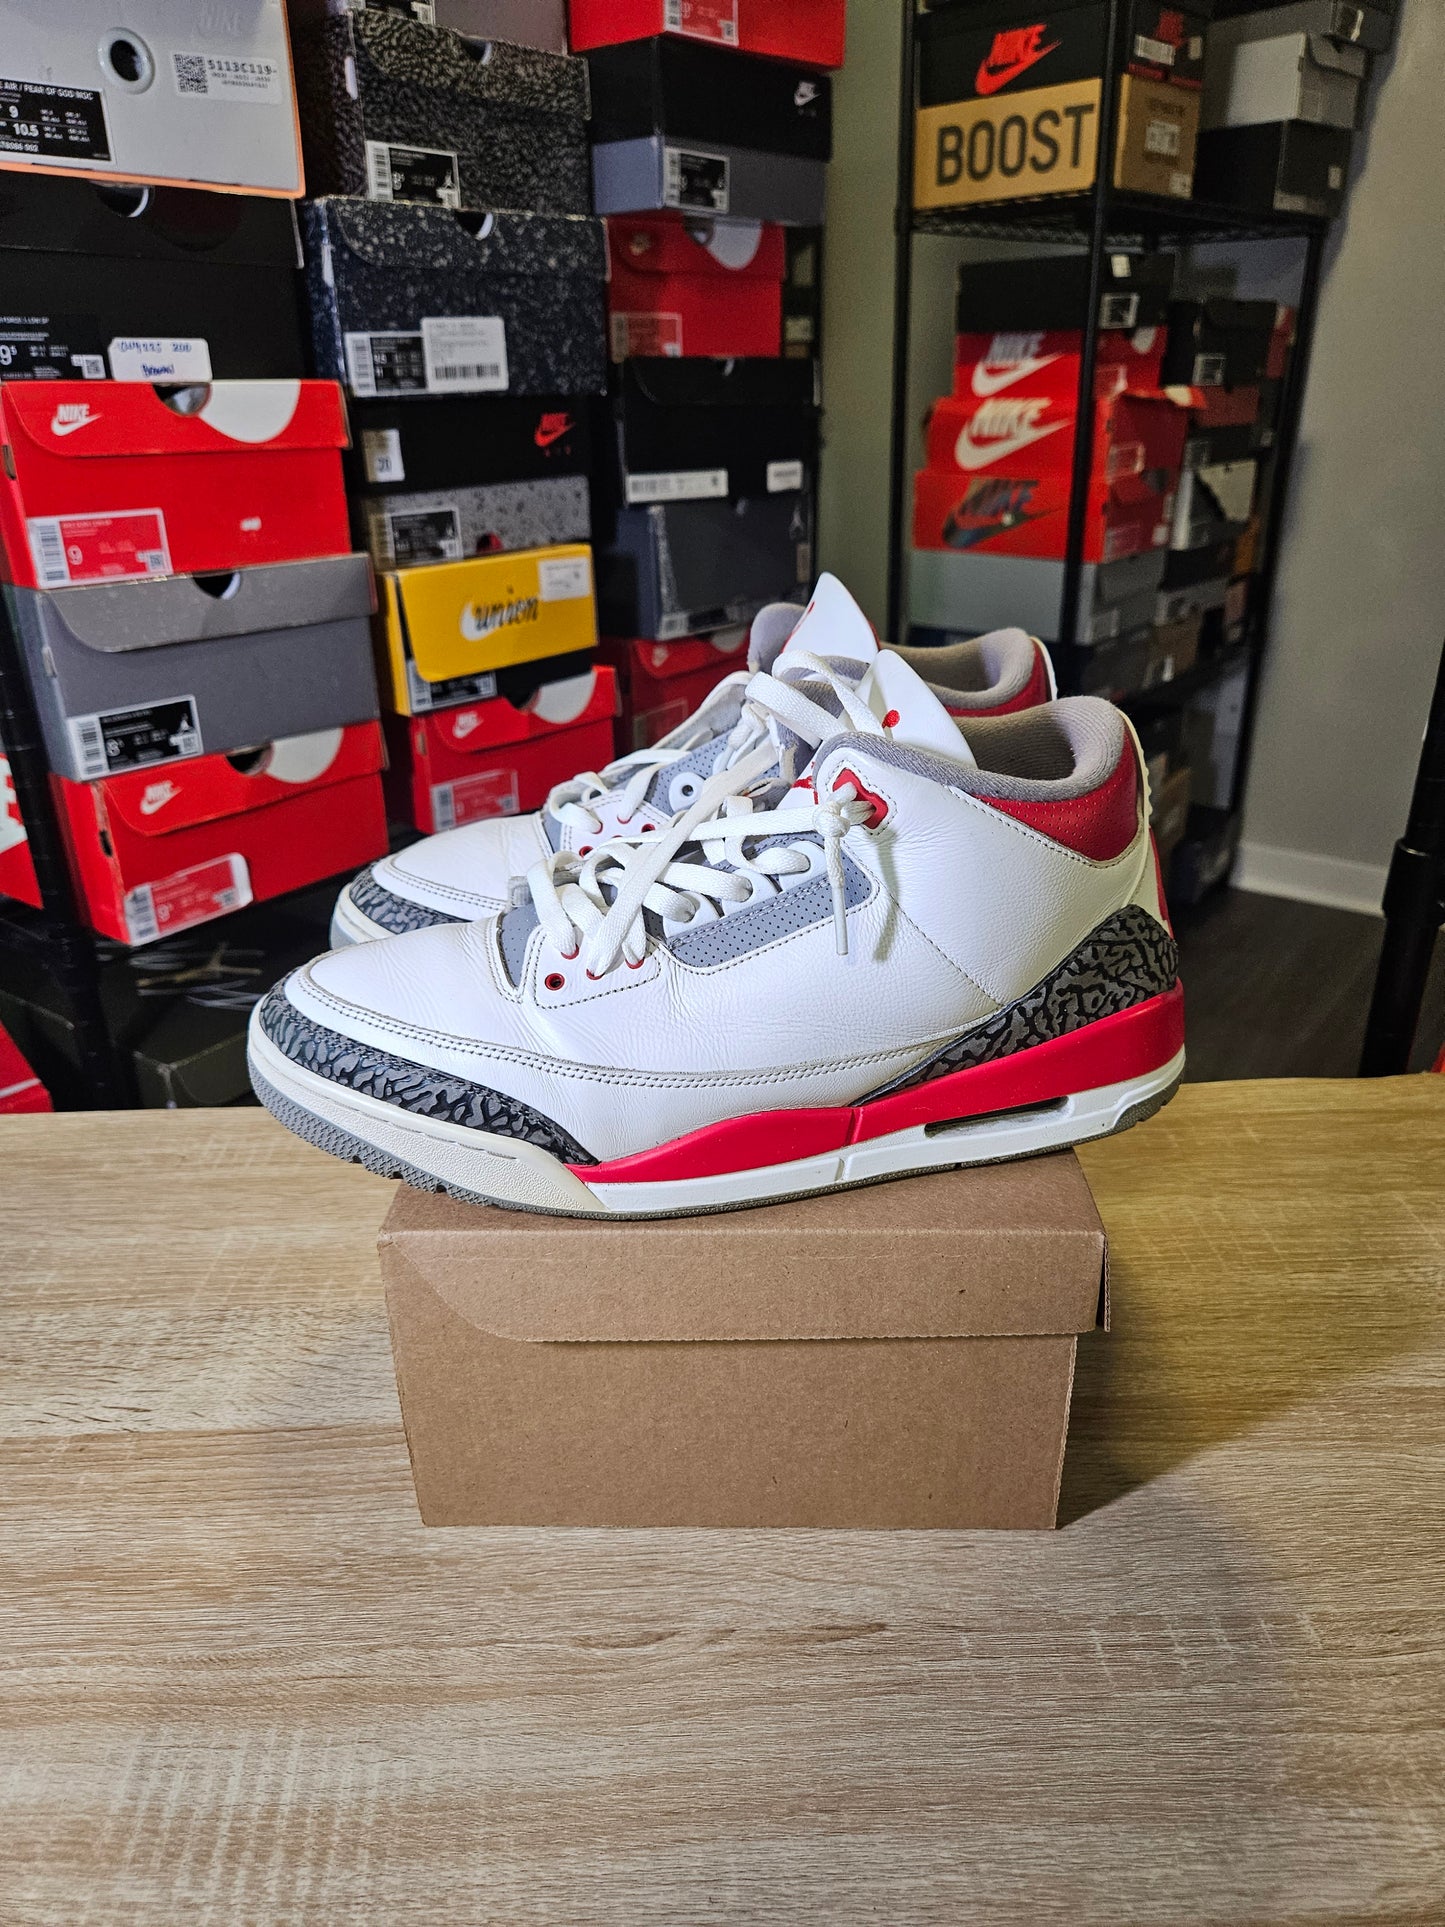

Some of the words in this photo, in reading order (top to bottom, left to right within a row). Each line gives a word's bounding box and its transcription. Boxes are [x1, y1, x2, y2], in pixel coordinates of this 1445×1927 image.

[23, 84, 45, 94] FEAR
[45, 87, 56, 96] OF
[57, 88, 75, 98] GOD
[9, 105, 19, 118] 9
[13, 123, 39, 137] 10.5
[936, 103, 1094, 187] BOOST
[67, 544, 83, 566] 9
[474, 584, 539, 632] union
